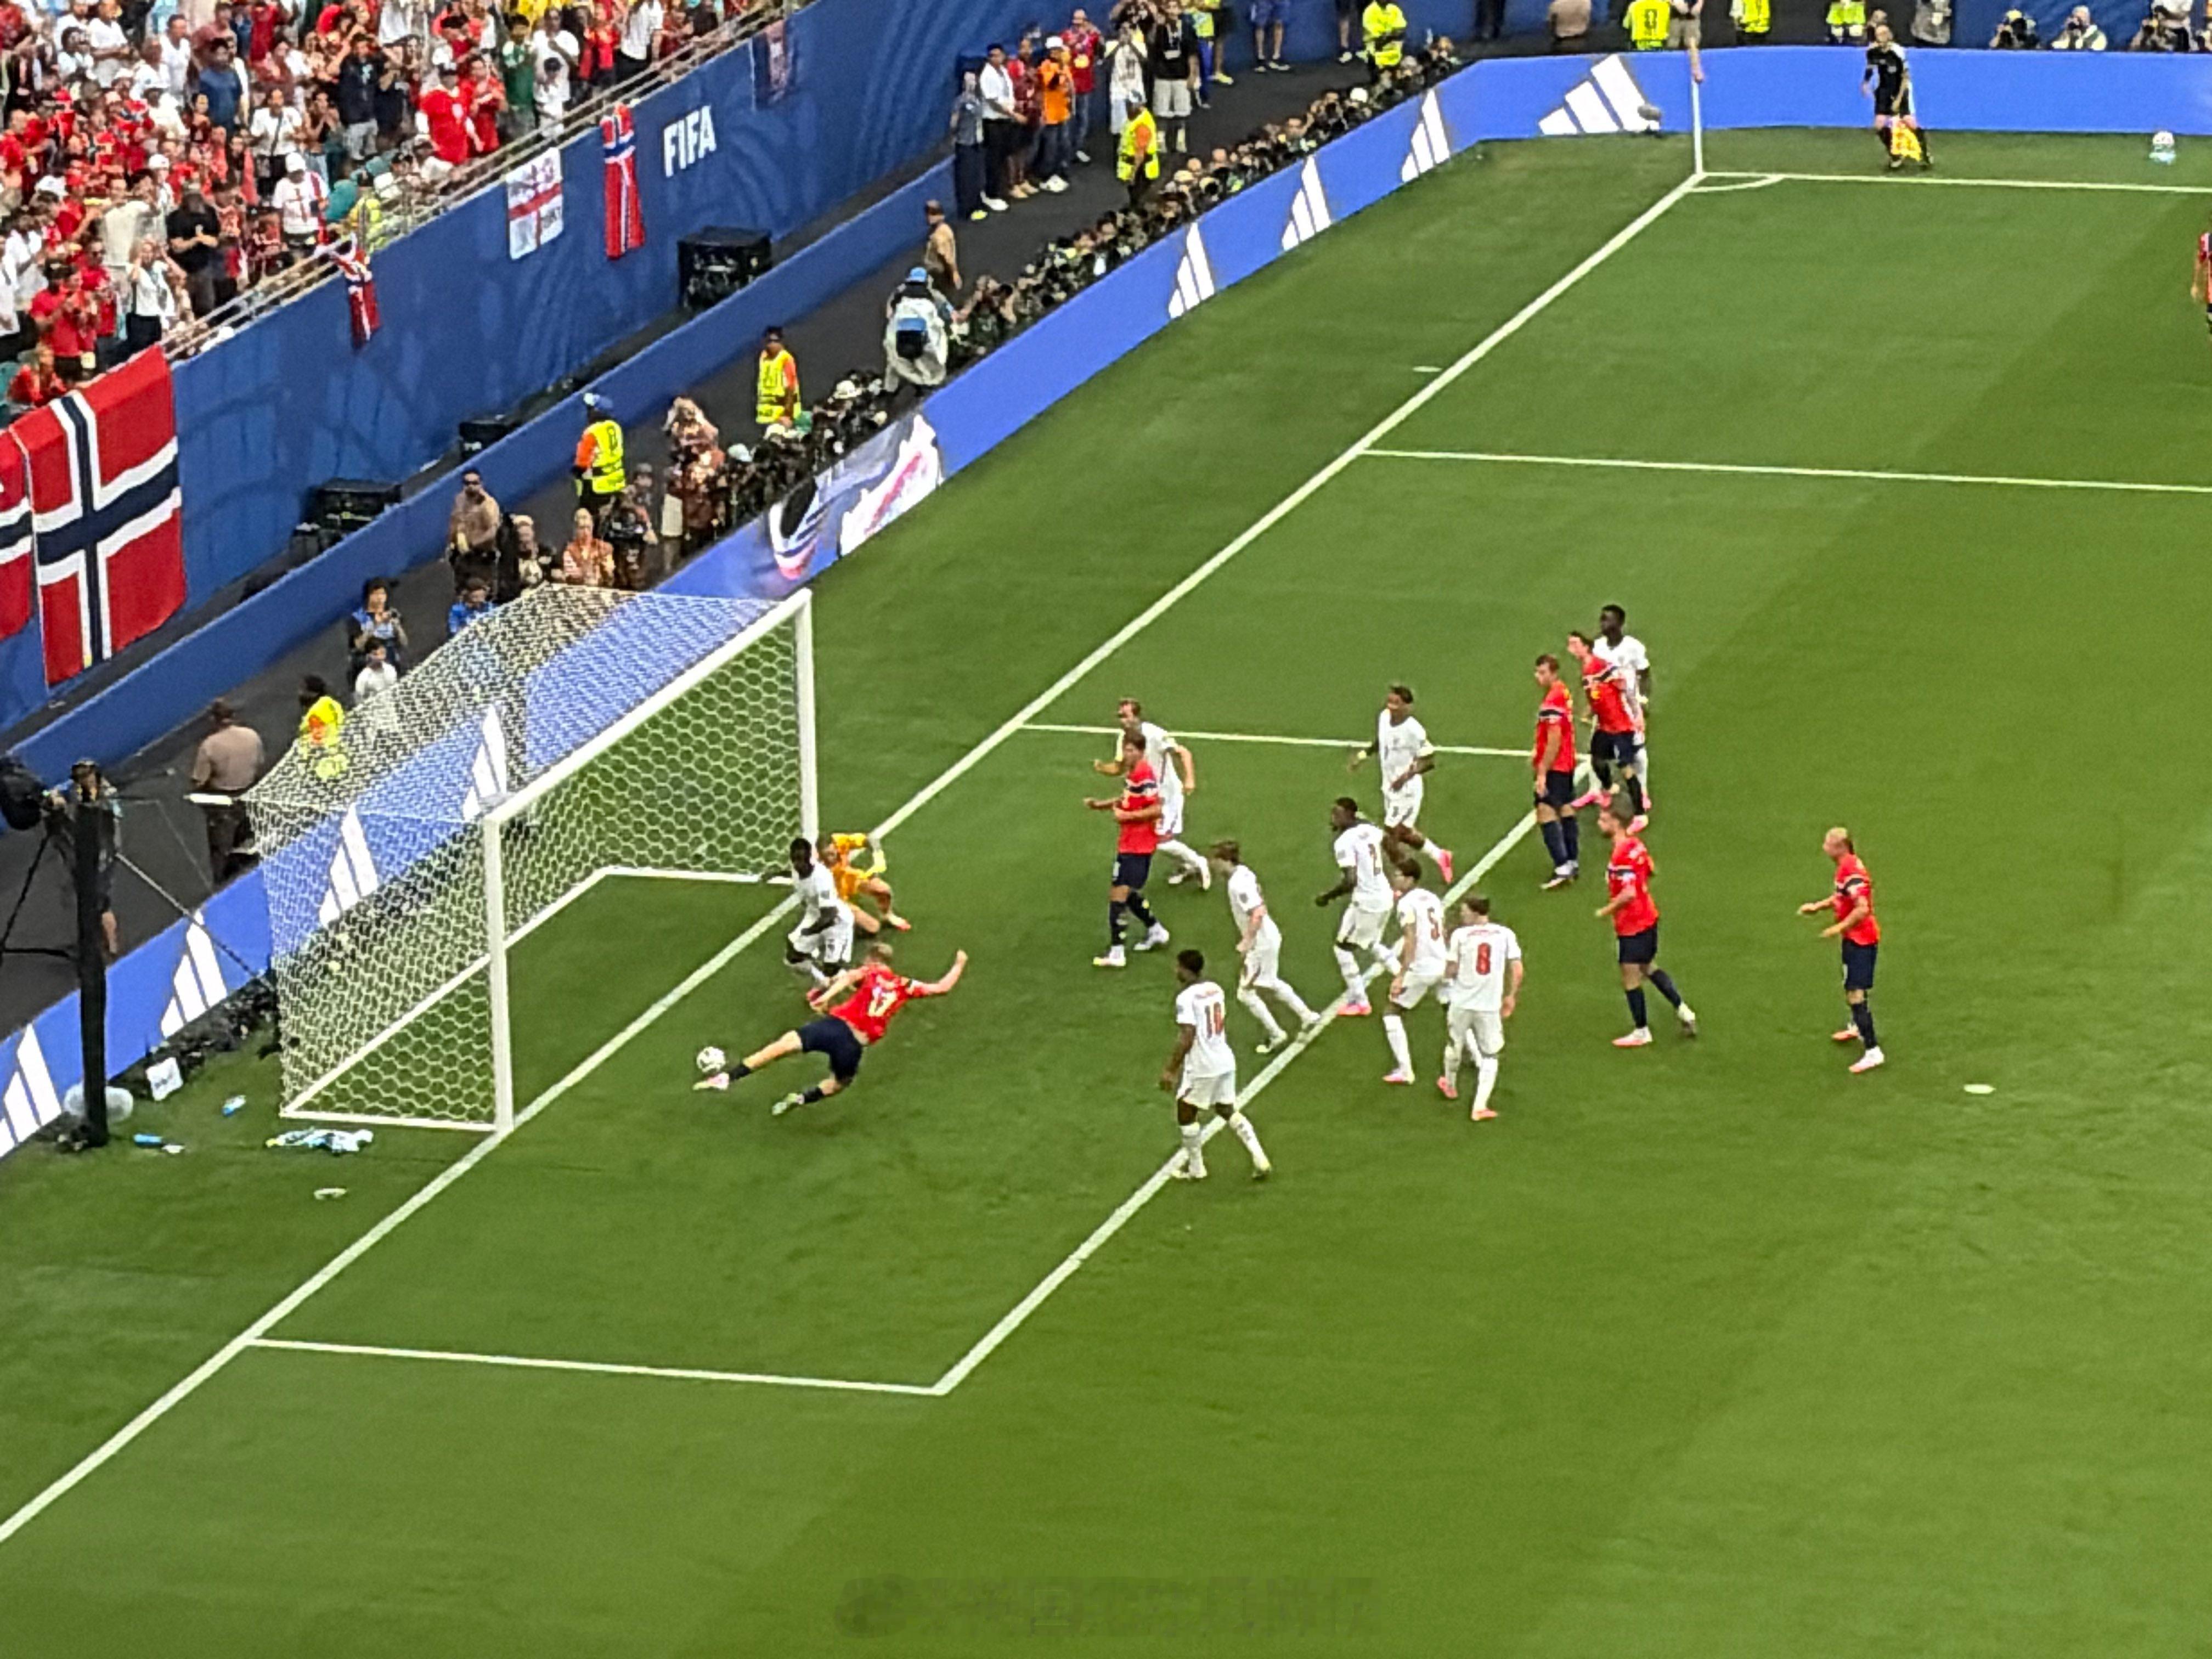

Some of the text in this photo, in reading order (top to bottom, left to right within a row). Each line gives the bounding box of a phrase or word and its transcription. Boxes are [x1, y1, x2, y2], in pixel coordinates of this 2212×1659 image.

[664, 104, 717, 178] FIFA
[1427, 907, 1440, 941] 5
[1476, 943, 1491, 975] 8
[1205, 1002, 1224, 1040] 10
